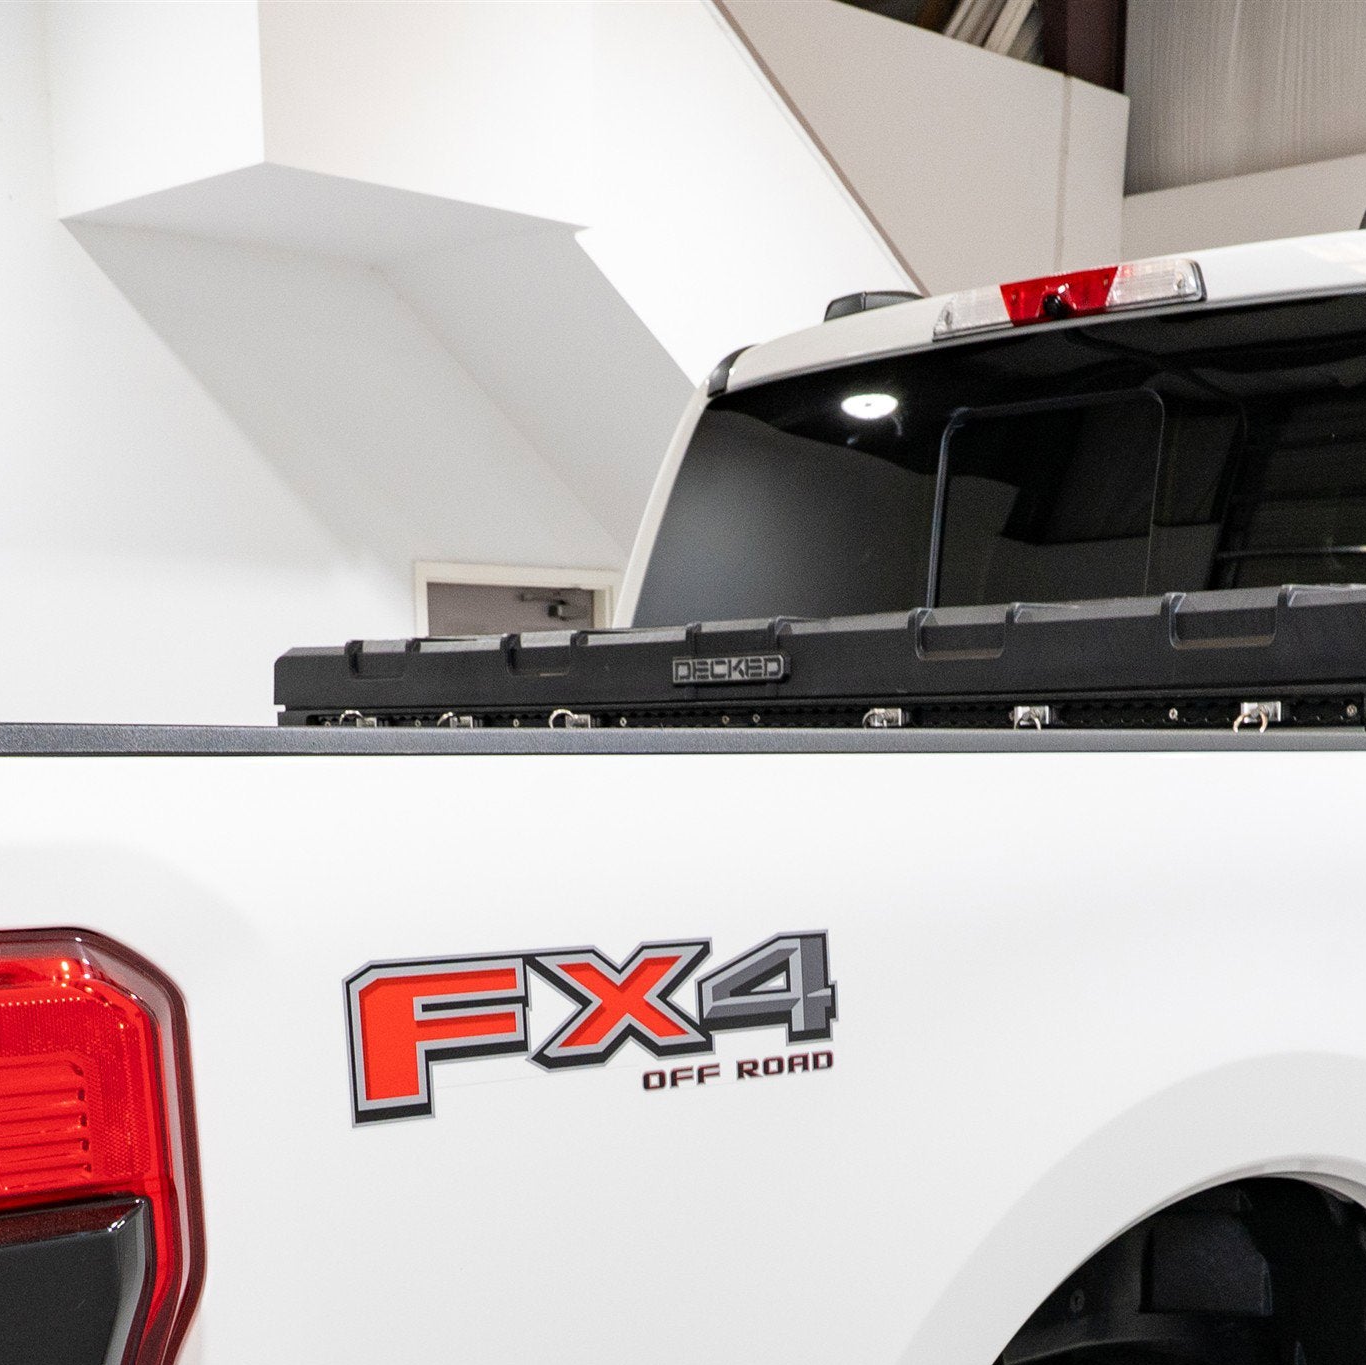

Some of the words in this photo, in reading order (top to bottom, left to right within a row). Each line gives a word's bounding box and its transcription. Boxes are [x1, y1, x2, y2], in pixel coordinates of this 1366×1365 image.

[674, 656, 784, 683] DECKED
[341, 929, 839, 1128] FX4
[642, 1063, 722, 1092] OFF
[735, 1049, 835, 1081] ROAD
